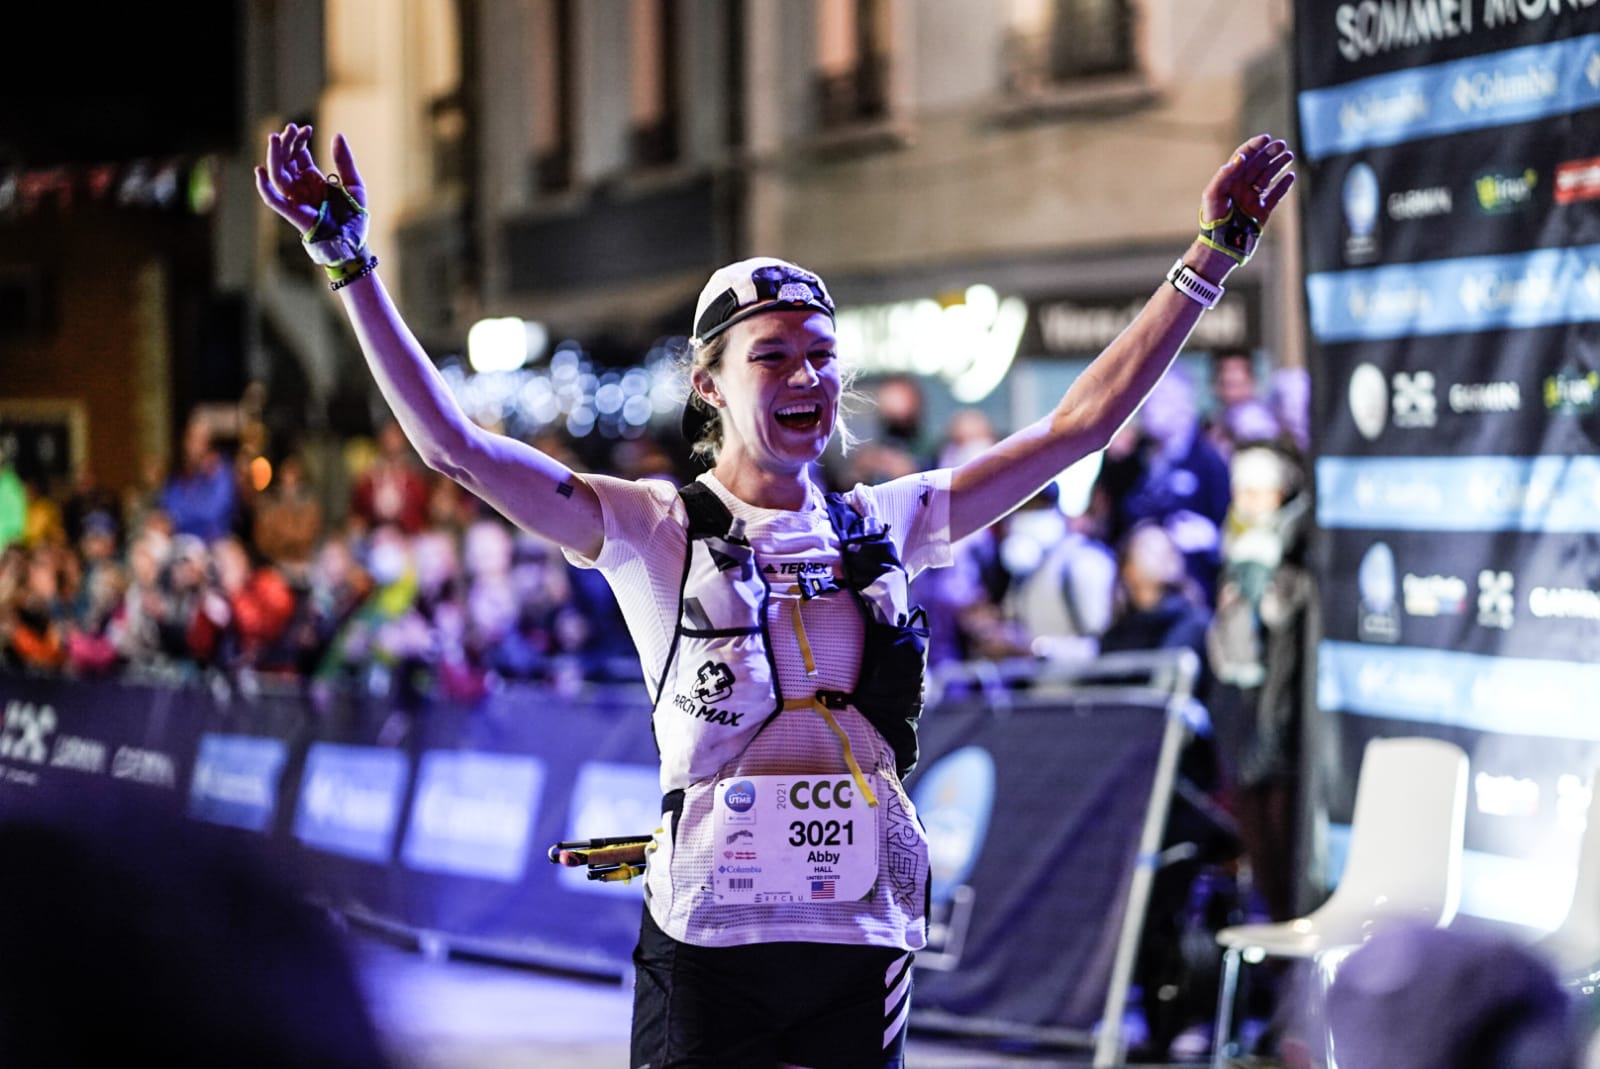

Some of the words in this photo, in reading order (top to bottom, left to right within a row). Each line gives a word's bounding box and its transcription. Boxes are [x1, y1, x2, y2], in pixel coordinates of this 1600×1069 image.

[780, 562, 827, 575] TERREX
[695, 705, 744, 727] MAX
[776, 783, 786, 810] 2021
[790, 780, 852, 810] CCC
[789, 820, 853, 847] 3021
[807, 851, 840, 864] Abby
